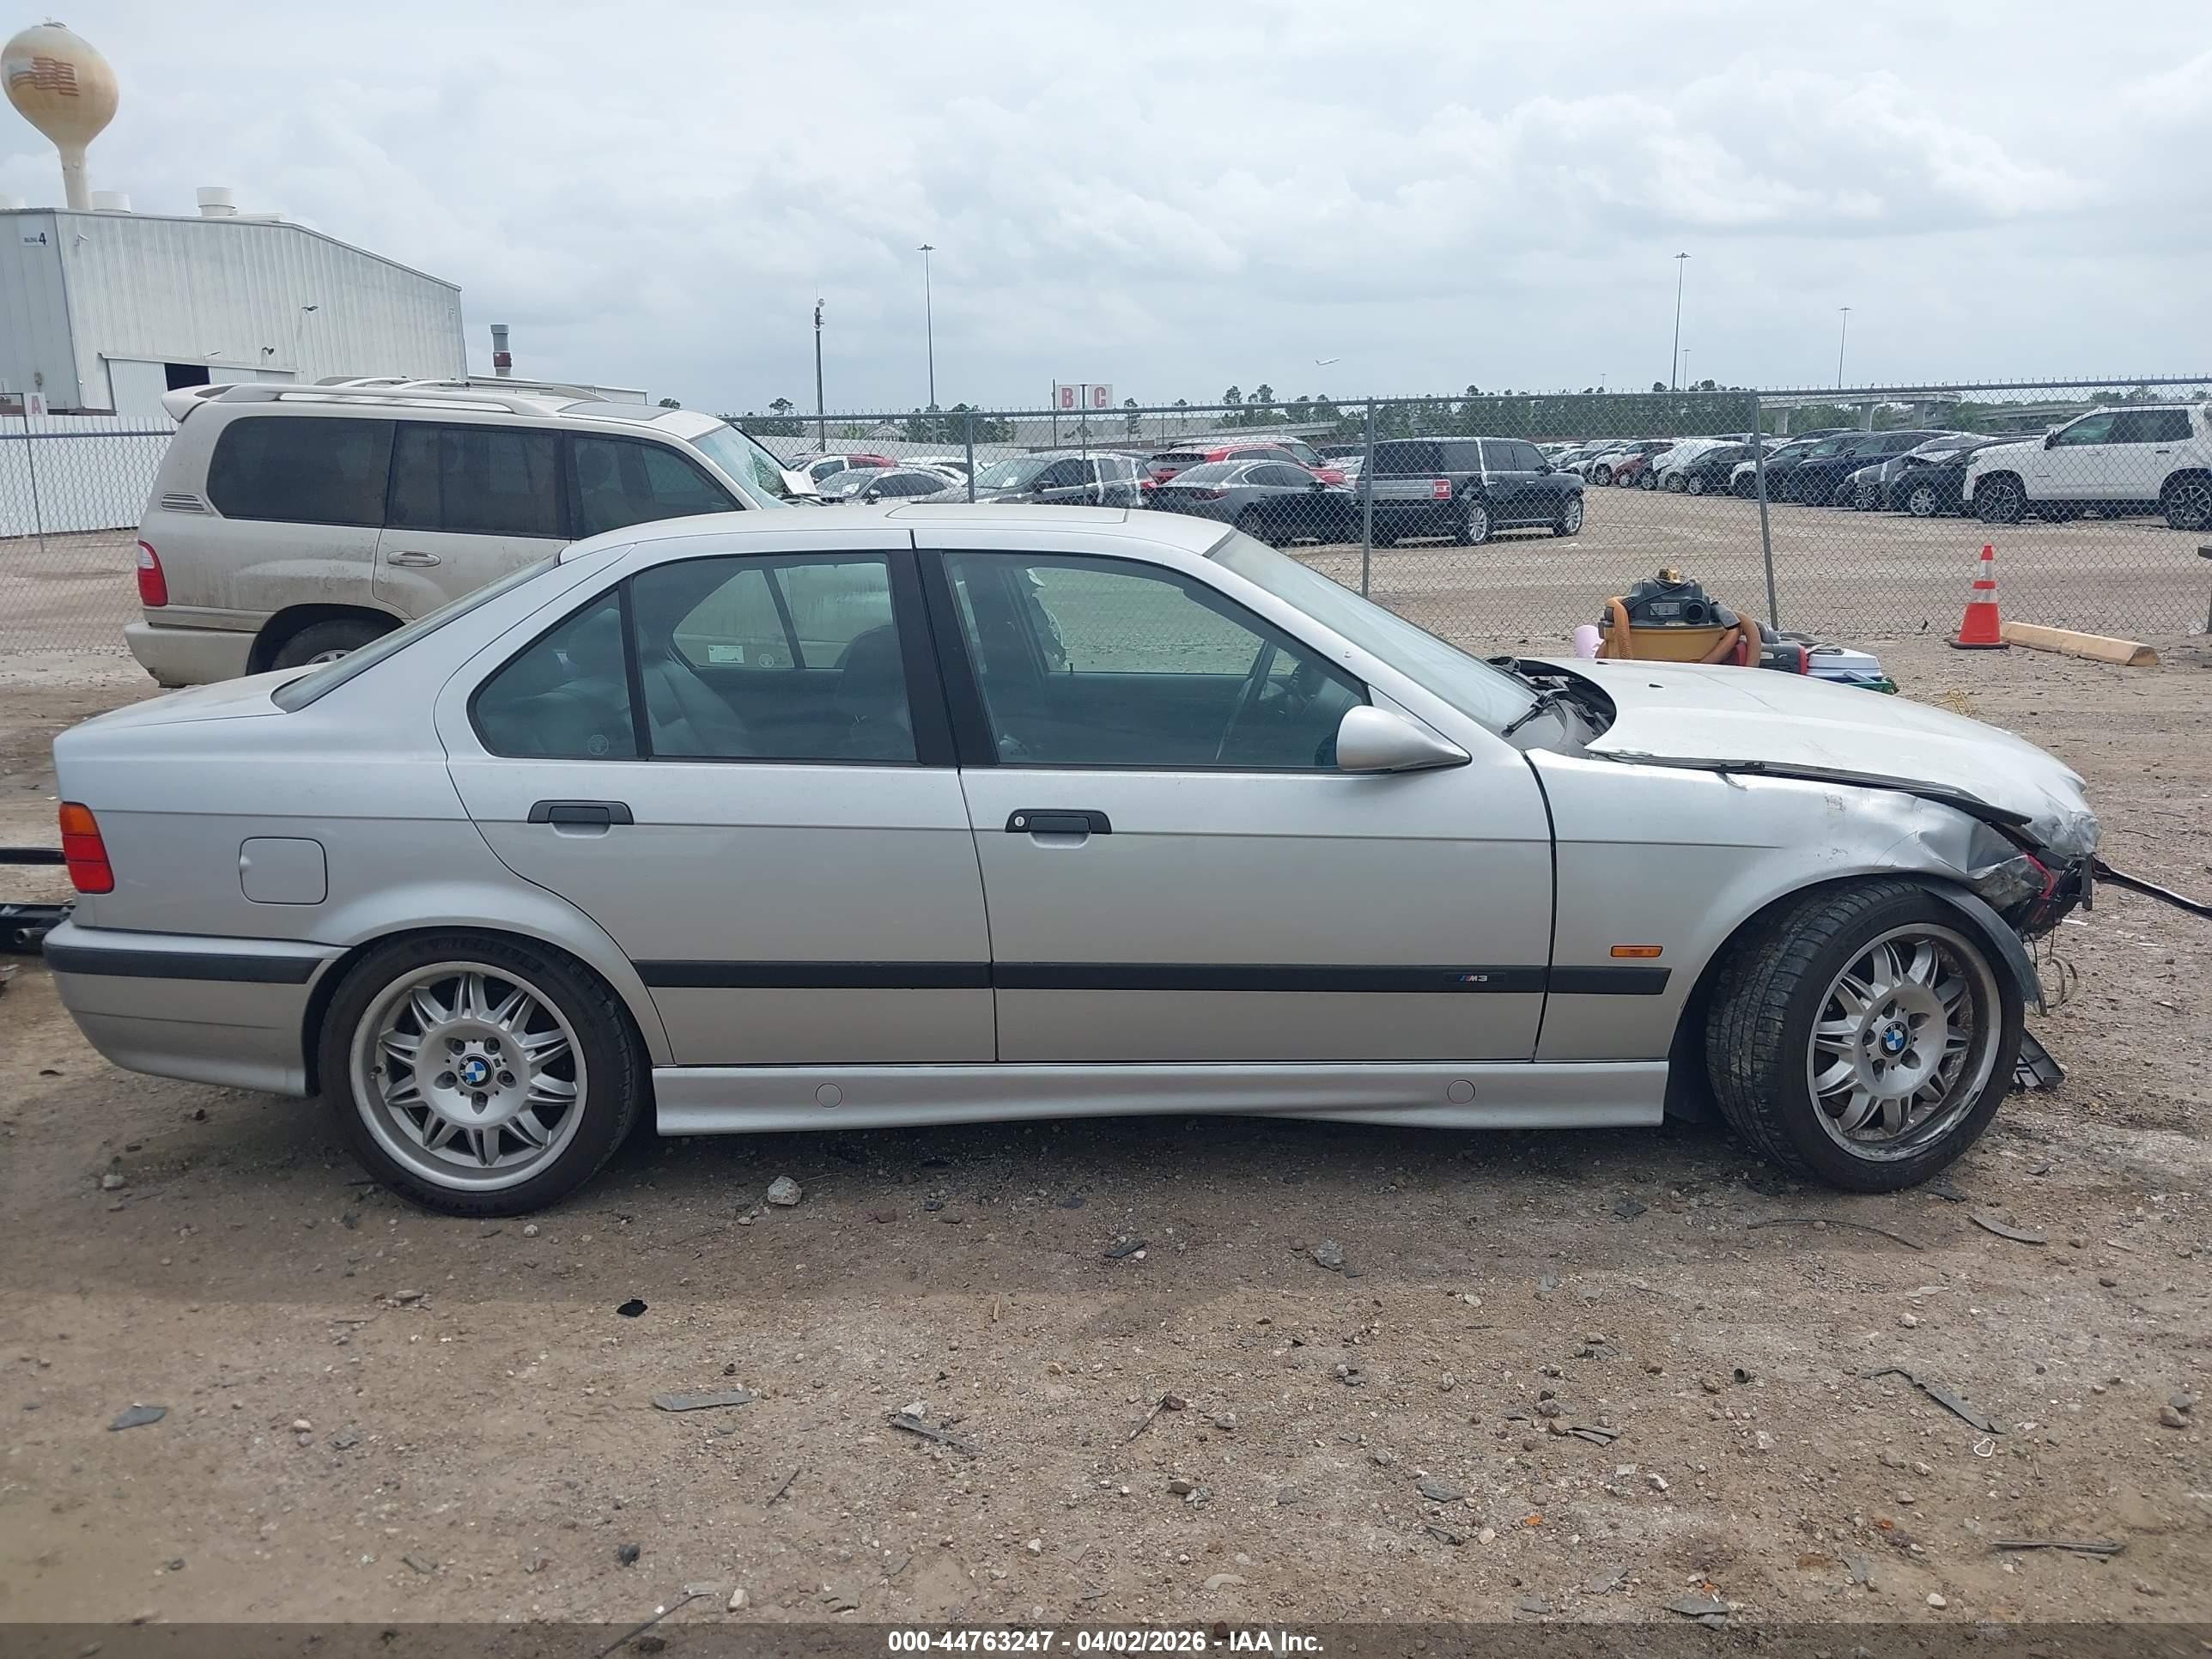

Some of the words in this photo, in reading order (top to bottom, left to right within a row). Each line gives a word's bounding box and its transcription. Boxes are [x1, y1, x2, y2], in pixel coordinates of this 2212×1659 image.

[39, 232, 47, 246] 4
[31, 395, 43, 415] A
[1061, 387, 1073, 408] B
[1094, 386, 1106, 408] C
